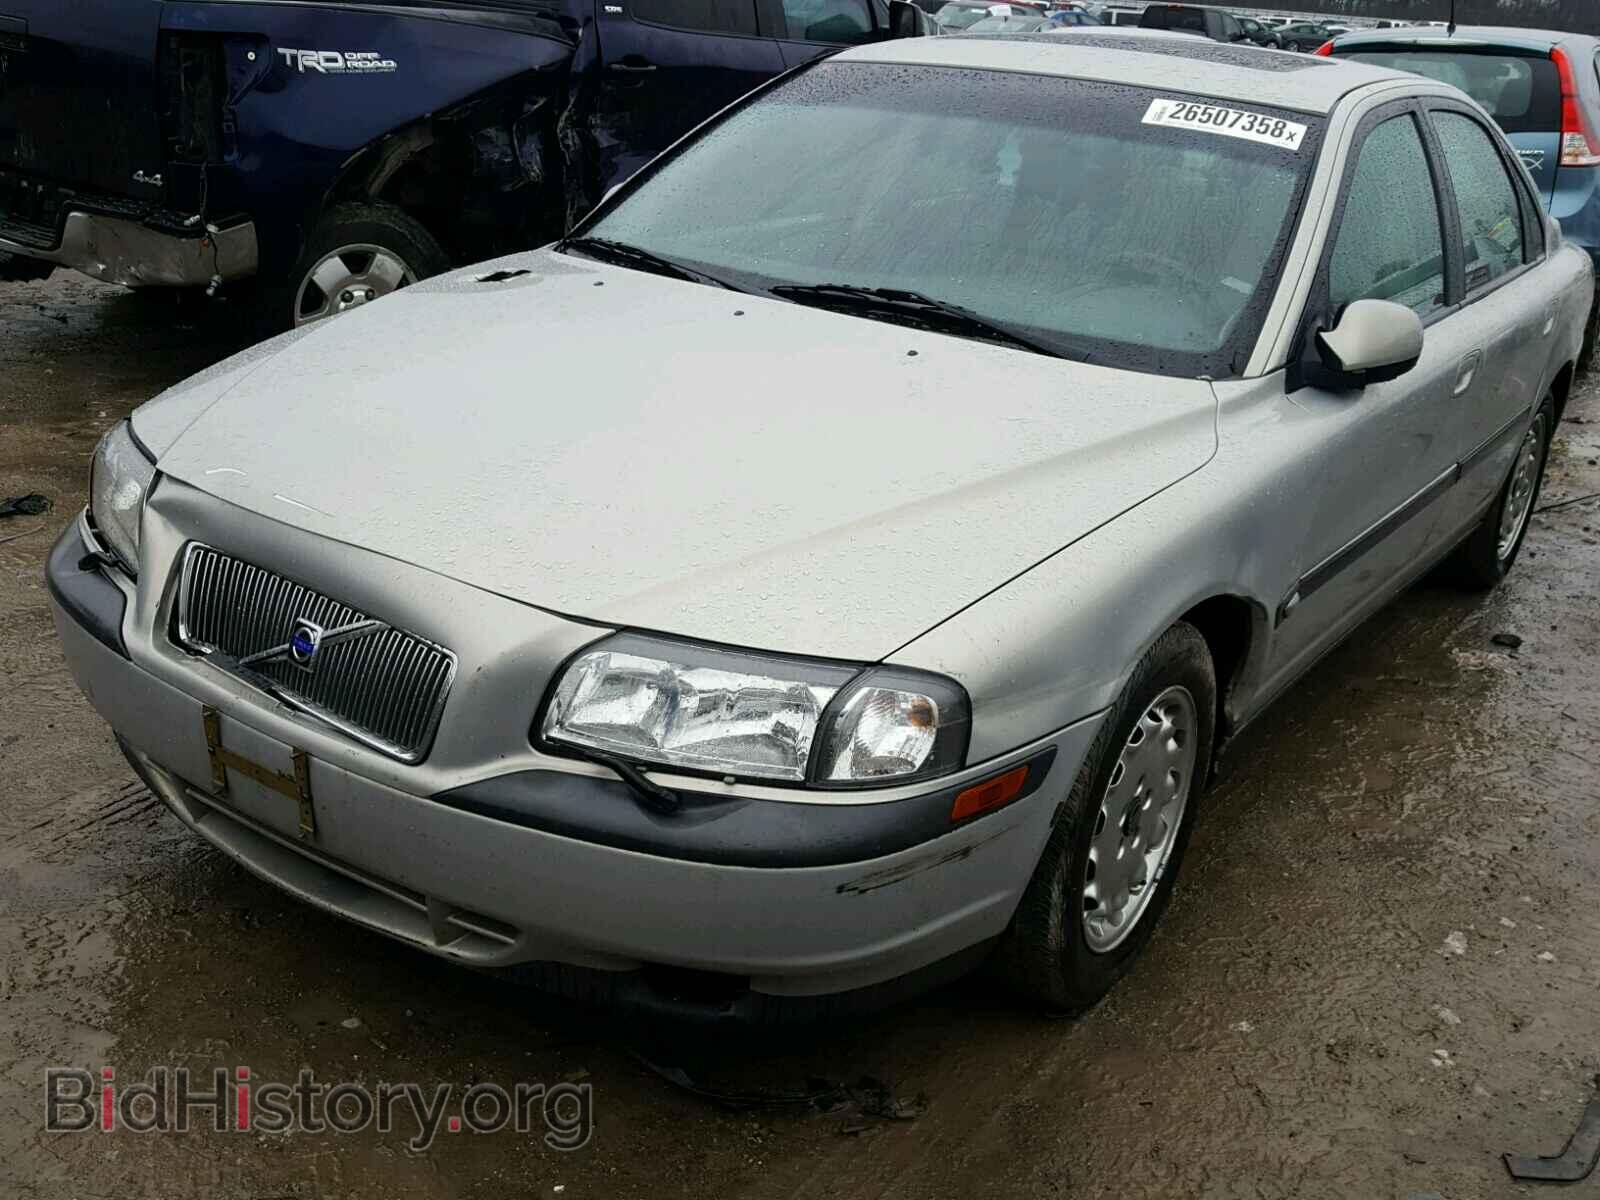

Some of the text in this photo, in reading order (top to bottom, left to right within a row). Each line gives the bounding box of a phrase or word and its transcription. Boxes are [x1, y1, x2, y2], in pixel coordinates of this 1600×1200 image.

[277, 48, 346, 73] TRD
[344, 52, 381, 60] OFF
[346, 60, 398, 69] ROAD
[1168, 102, 1287, 139] 26507358
